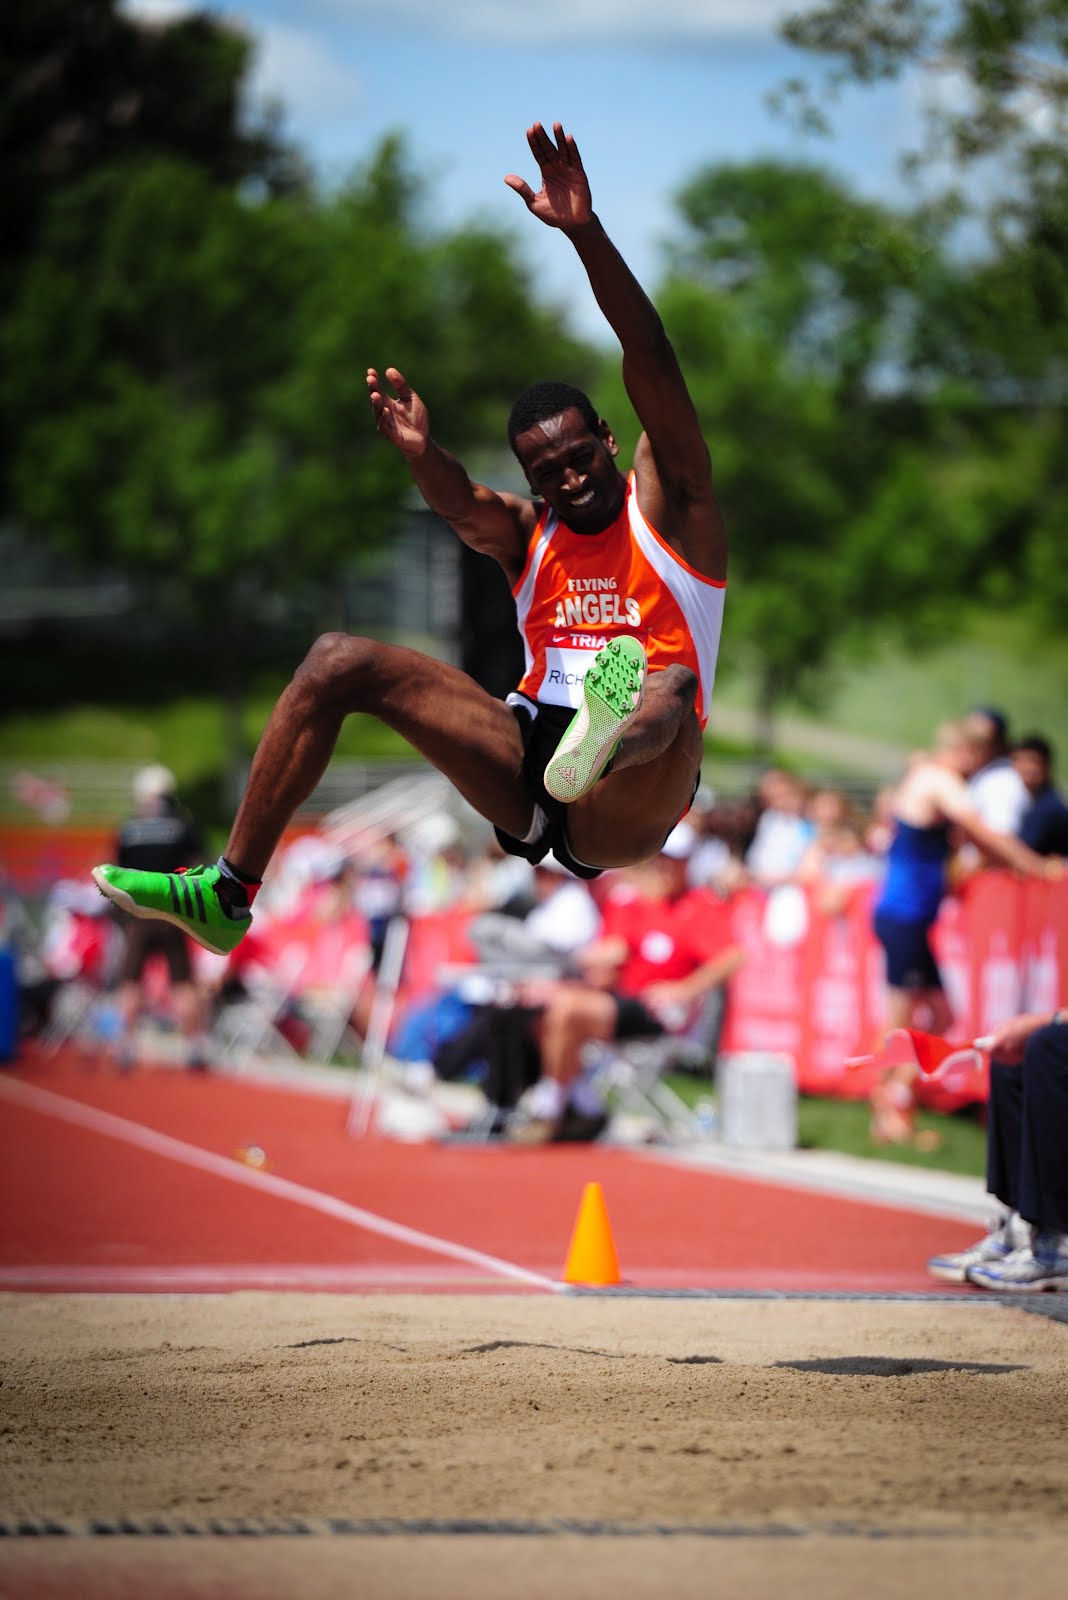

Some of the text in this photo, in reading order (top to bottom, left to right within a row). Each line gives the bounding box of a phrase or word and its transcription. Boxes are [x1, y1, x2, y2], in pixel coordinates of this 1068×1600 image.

[567, 576, 618, 593] FLYING
[553, 594, 642, 628] ANGELS
[570, 633, 613, 649] TRIA
